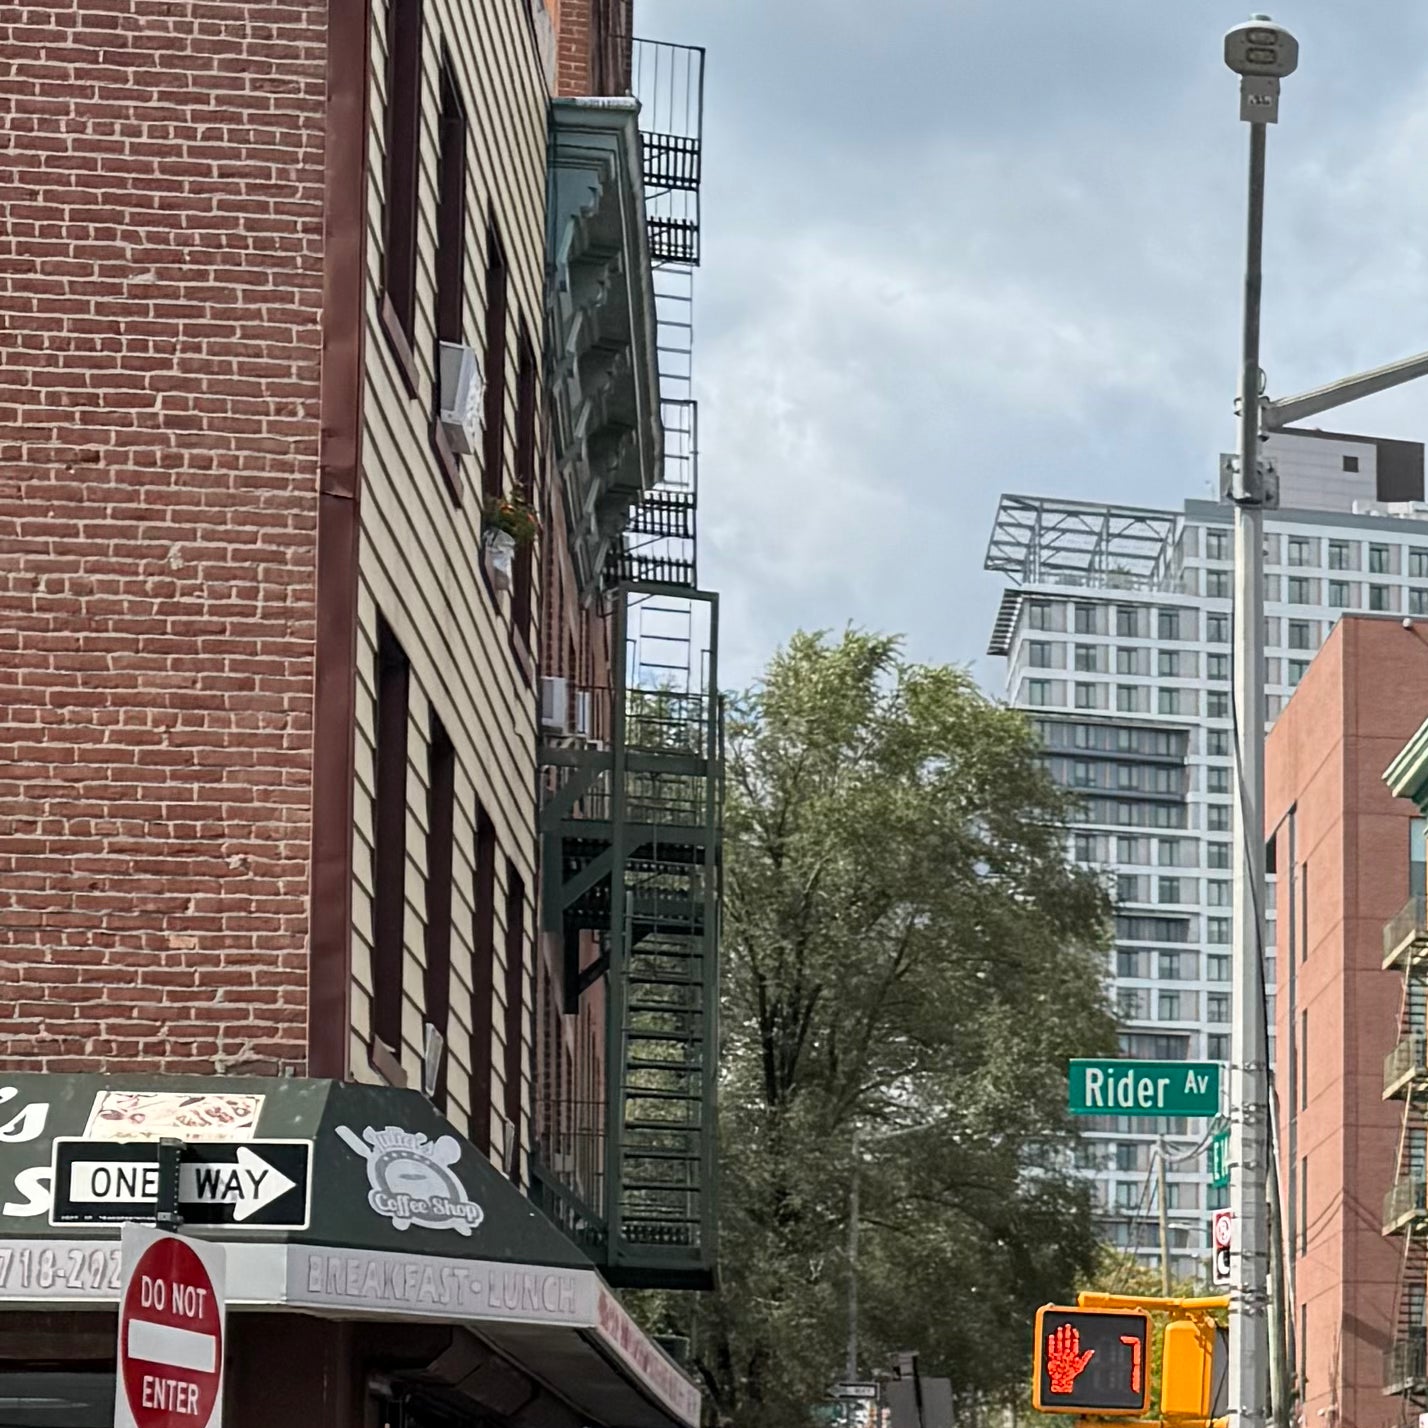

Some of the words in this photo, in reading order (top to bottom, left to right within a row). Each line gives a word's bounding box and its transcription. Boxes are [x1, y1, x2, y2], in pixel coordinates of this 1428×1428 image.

[1085, 1067, 1170, 1108] Rider
[1184, 1070, 1209, 1094] Av
[91, 1167, 160, 1198] ONE
[195, 1168, 270, 1200] WAY
[375, 1193, 430, 1218] Coffee
[431, 1196, 479, 1223] Shop
[141, 1275, 165, 1311] DO
[172, 1282, 207, 1319] NOT
[487, 1268, 577, 1315] LUNCH
[142, 1375, 199, 1416] ENTER
